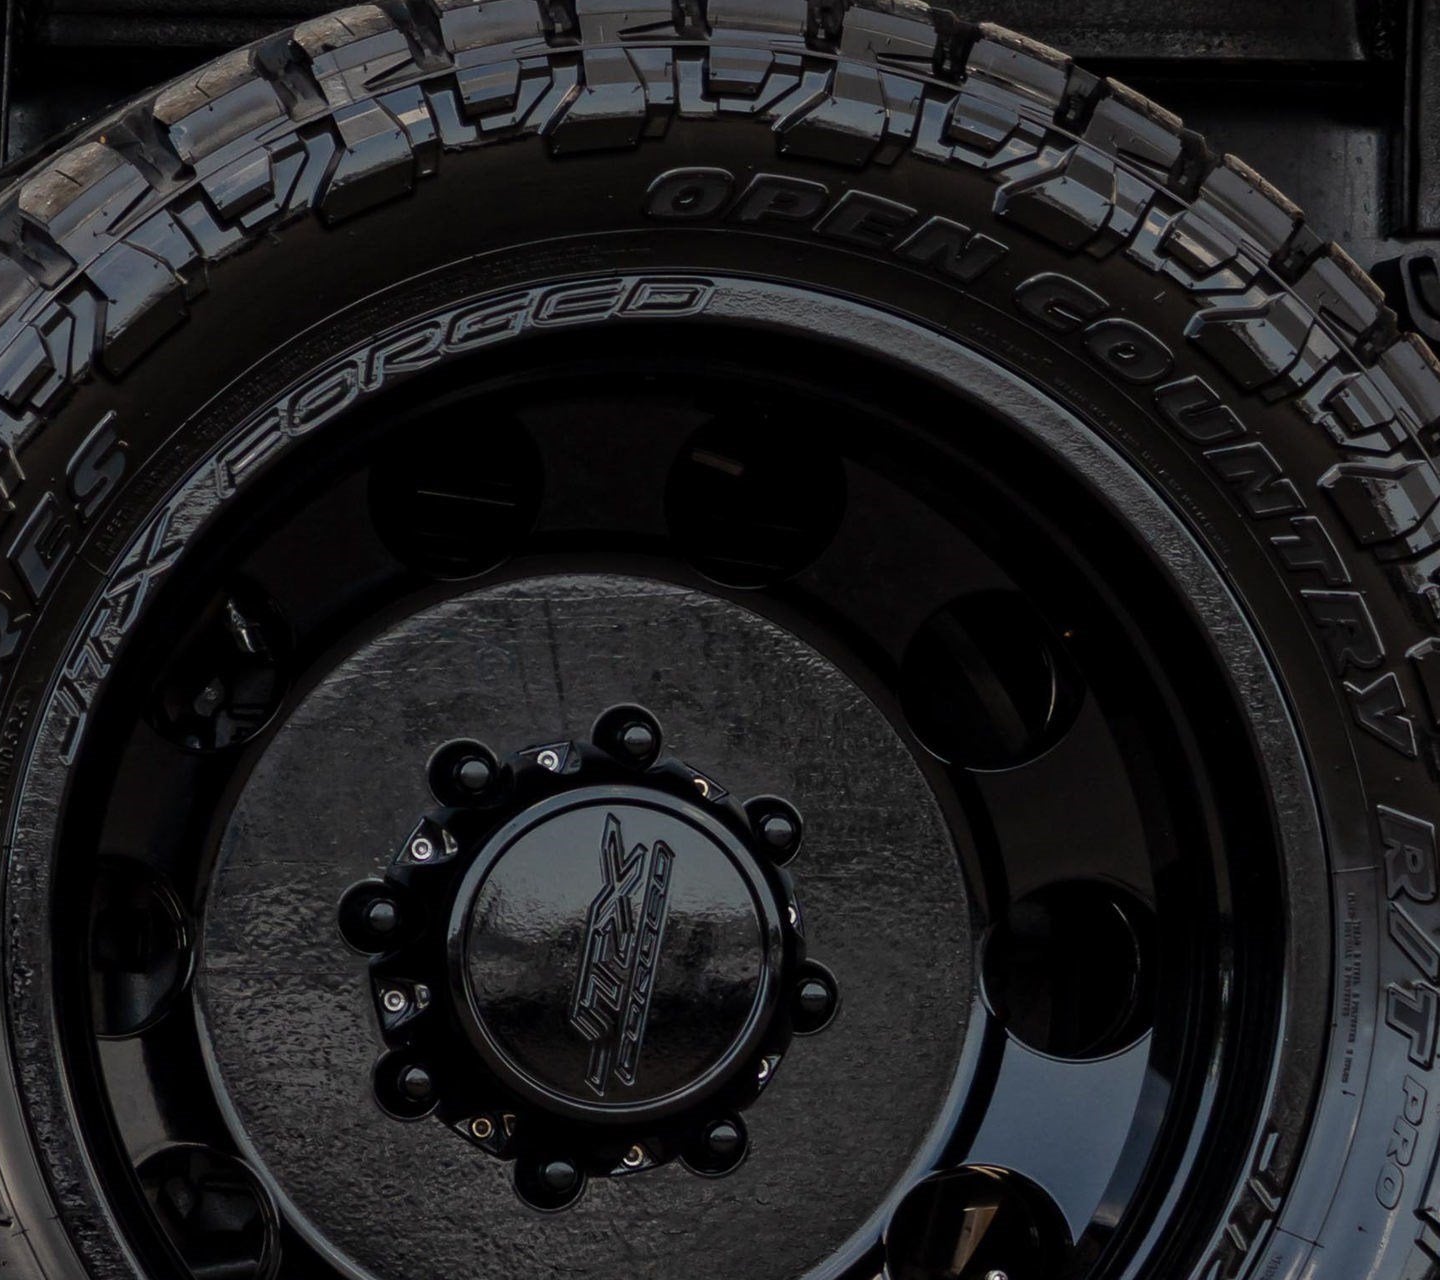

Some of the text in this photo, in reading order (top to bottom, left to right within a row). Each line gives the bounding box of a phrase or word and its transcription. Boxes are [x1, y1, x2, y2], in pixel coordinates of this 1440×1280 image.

[54, 501, 186, 766] JTX
[210, 274, 716, 500] FORGED
[644, 167, 1011, 284] OPEN
[1011, 270, 1418, 756] COUNTRY
[1375, 1074, 1428, 1211] PRO
[614, 839, 676, 1086] FORGED
